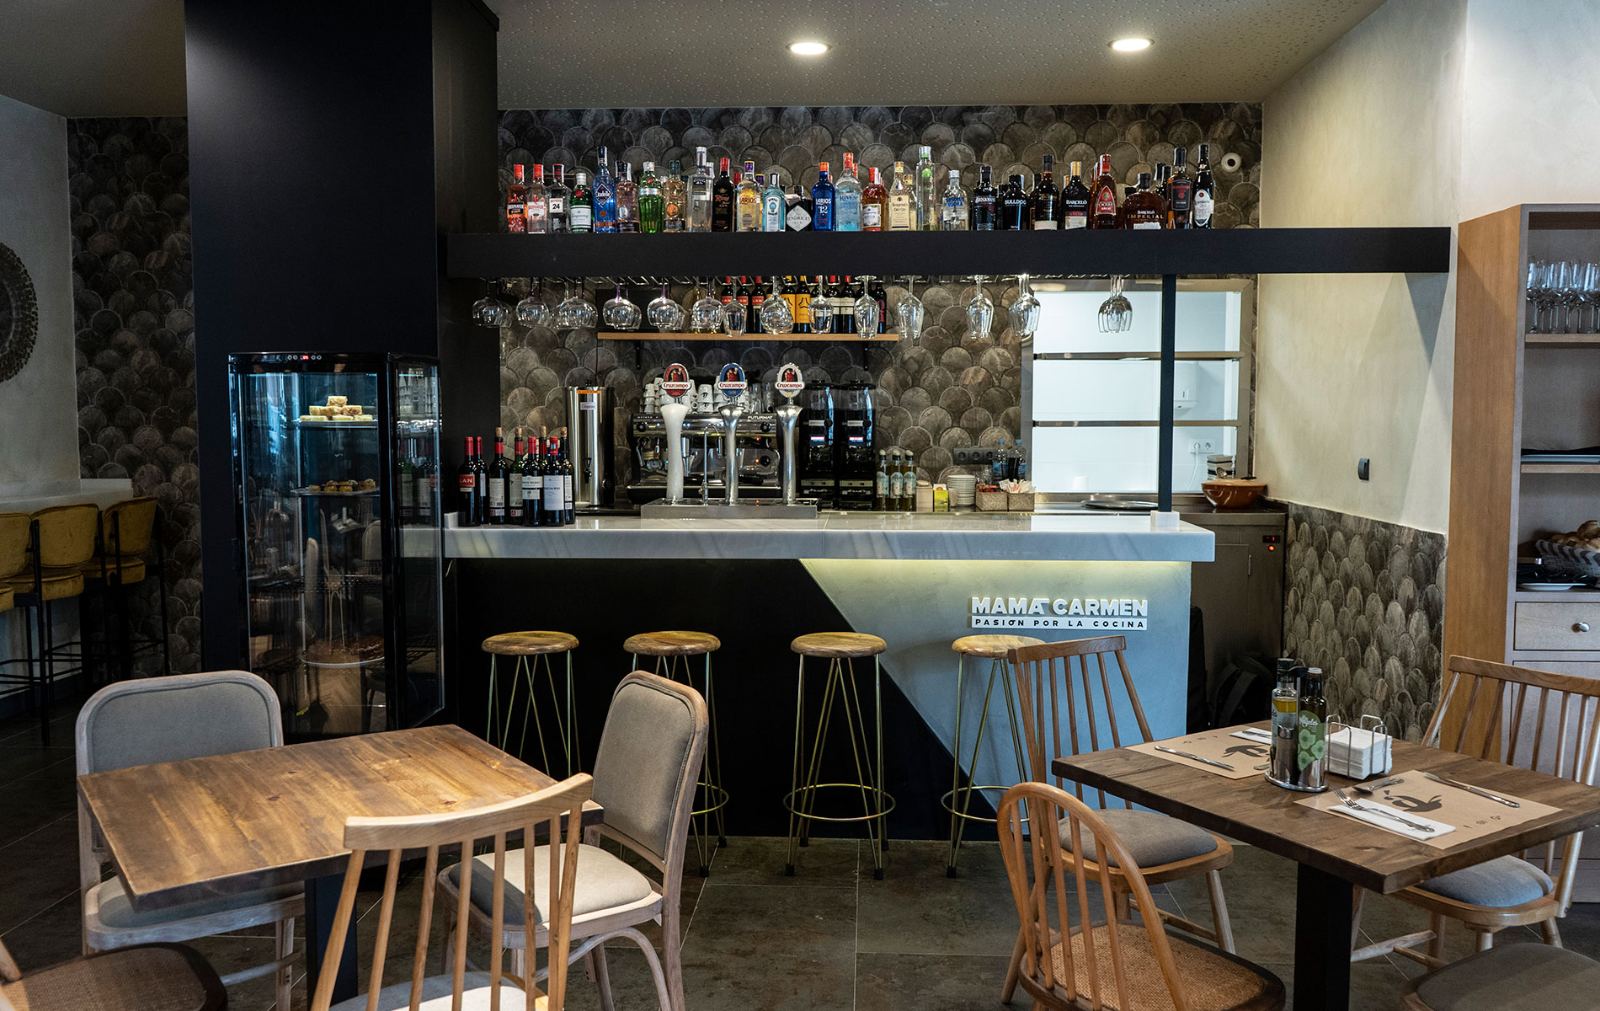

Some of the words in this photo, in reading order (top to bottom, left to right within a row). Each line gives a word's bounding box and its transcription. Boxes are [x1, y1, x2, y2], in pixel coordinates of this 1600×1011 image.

[818, 205, 828, 213] 12
[1052, 598, 1148, 617] CARMEN
[1033, 619, 1060, 627] POR
[1093, 620, 1145, 628] COCINA
